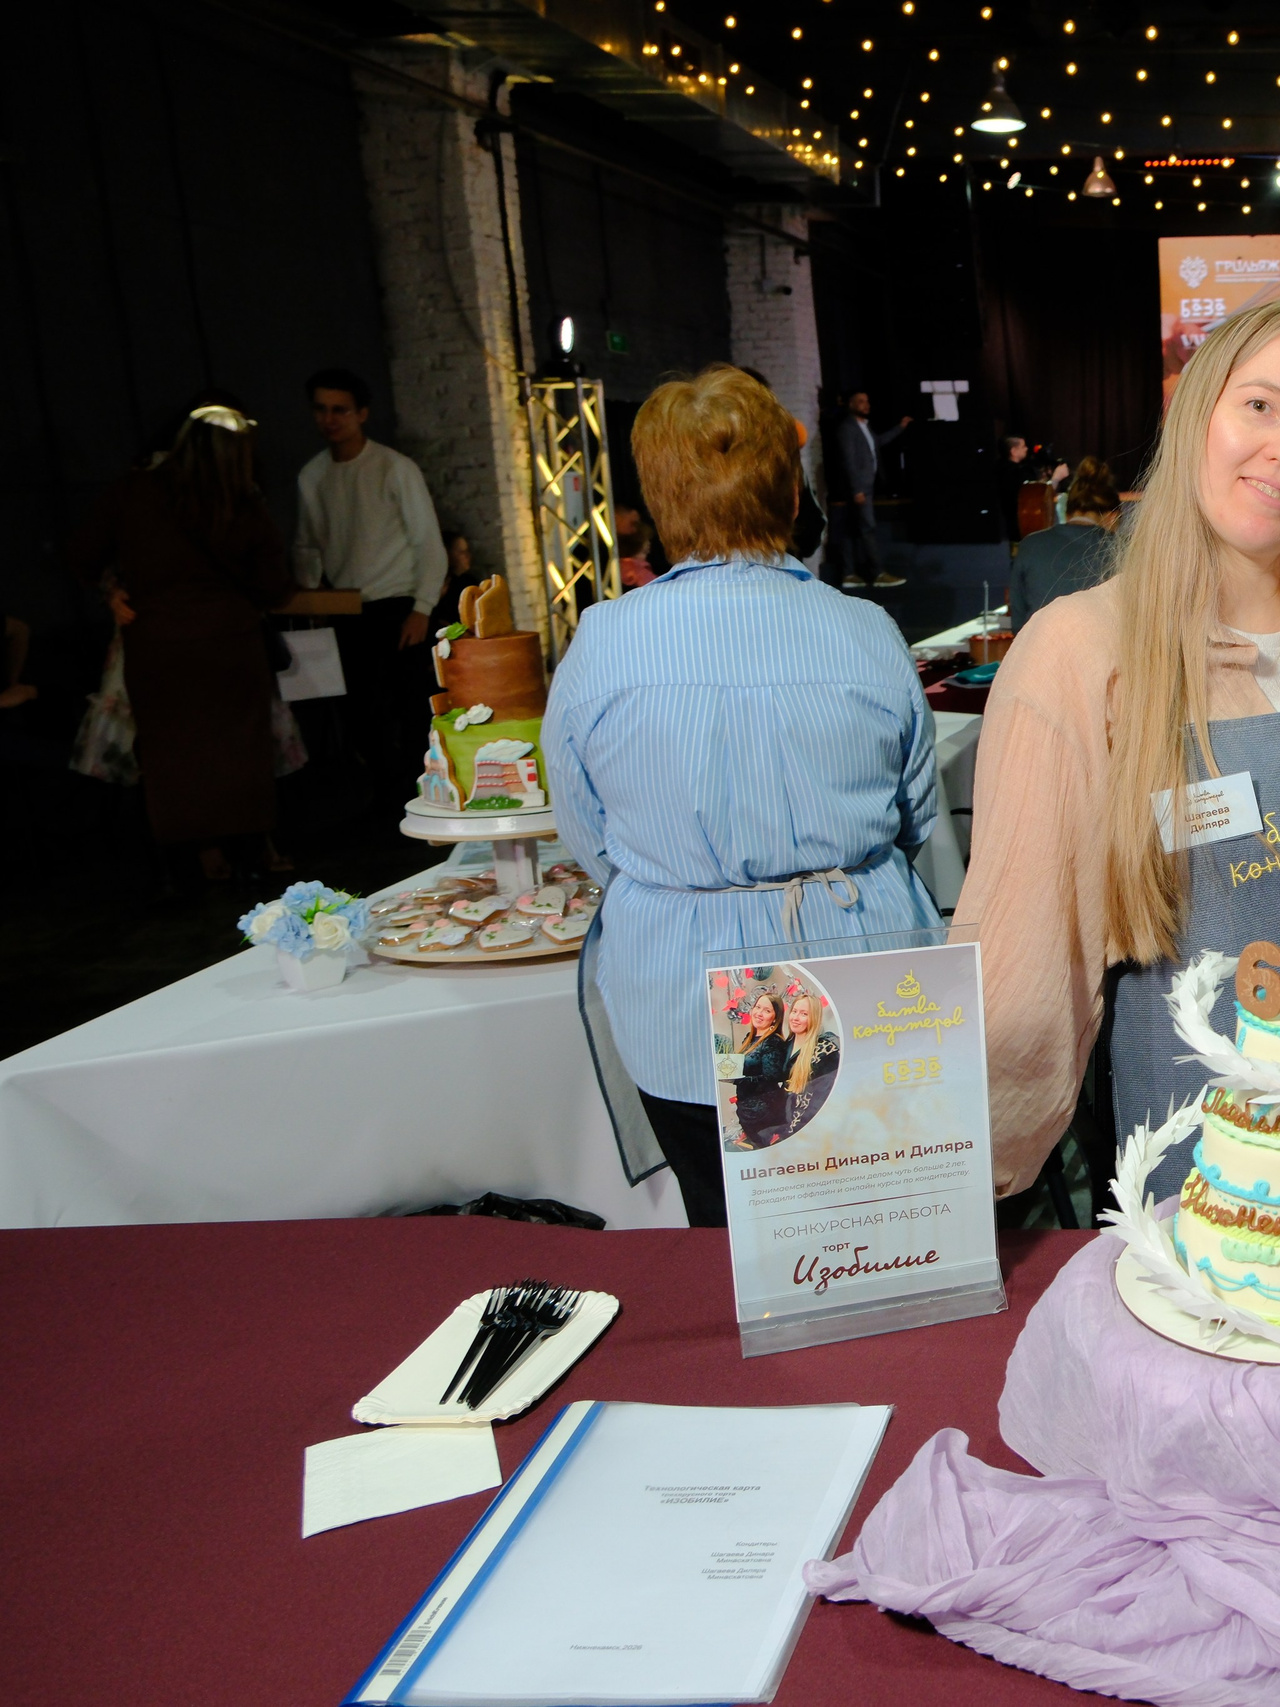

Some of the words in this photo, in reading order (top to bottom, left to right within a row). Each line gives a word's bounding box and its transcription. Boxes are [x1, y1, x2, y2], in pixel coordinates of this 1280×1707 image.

[1184, 806, 1230, 822] Шагаева
[1190, 818, 1230, 834] Диляра
[877, 994, 941, 1018] битва
[853, 1005, 966, 1047] кондитеров
[740, 1160, 820, 1181] Шагаевы
[824, 1151, 890, 1171] Динара
[895, 1148, 905, 1159] и
[910, 1139, 974, 1158] Диляра
[751, 1182, 806, 1197] Занимаемся
[806, 1174, 867, 1189] кондитерским
[867, 1170, 894, 1181] делом
[894, 1167, 912, 1177] чуть
[913, 1162, 945, 1175] больше
[945, 1161, 952, 1169] 2
[952, 1159, 967, 1168] лет.
[748, 1194, 796, 1207] Проходили
[797, 1187, 837, 1201] оффлайн
[844, 1181, 876, 1193] онлайн
[876, 1178, 902, 1190] курсы
[903, 1176, 914, 1184] по
[915, 1169, 971, 1184] кондитерству.
[773, 1213, 884, 1240] КОНКУРСНАЯ
[889, 1203, 951, 1223] РАБОТА
[822, 1242, 851, 1253] торт
[793, 1245, 940, 1296] Изобилие
